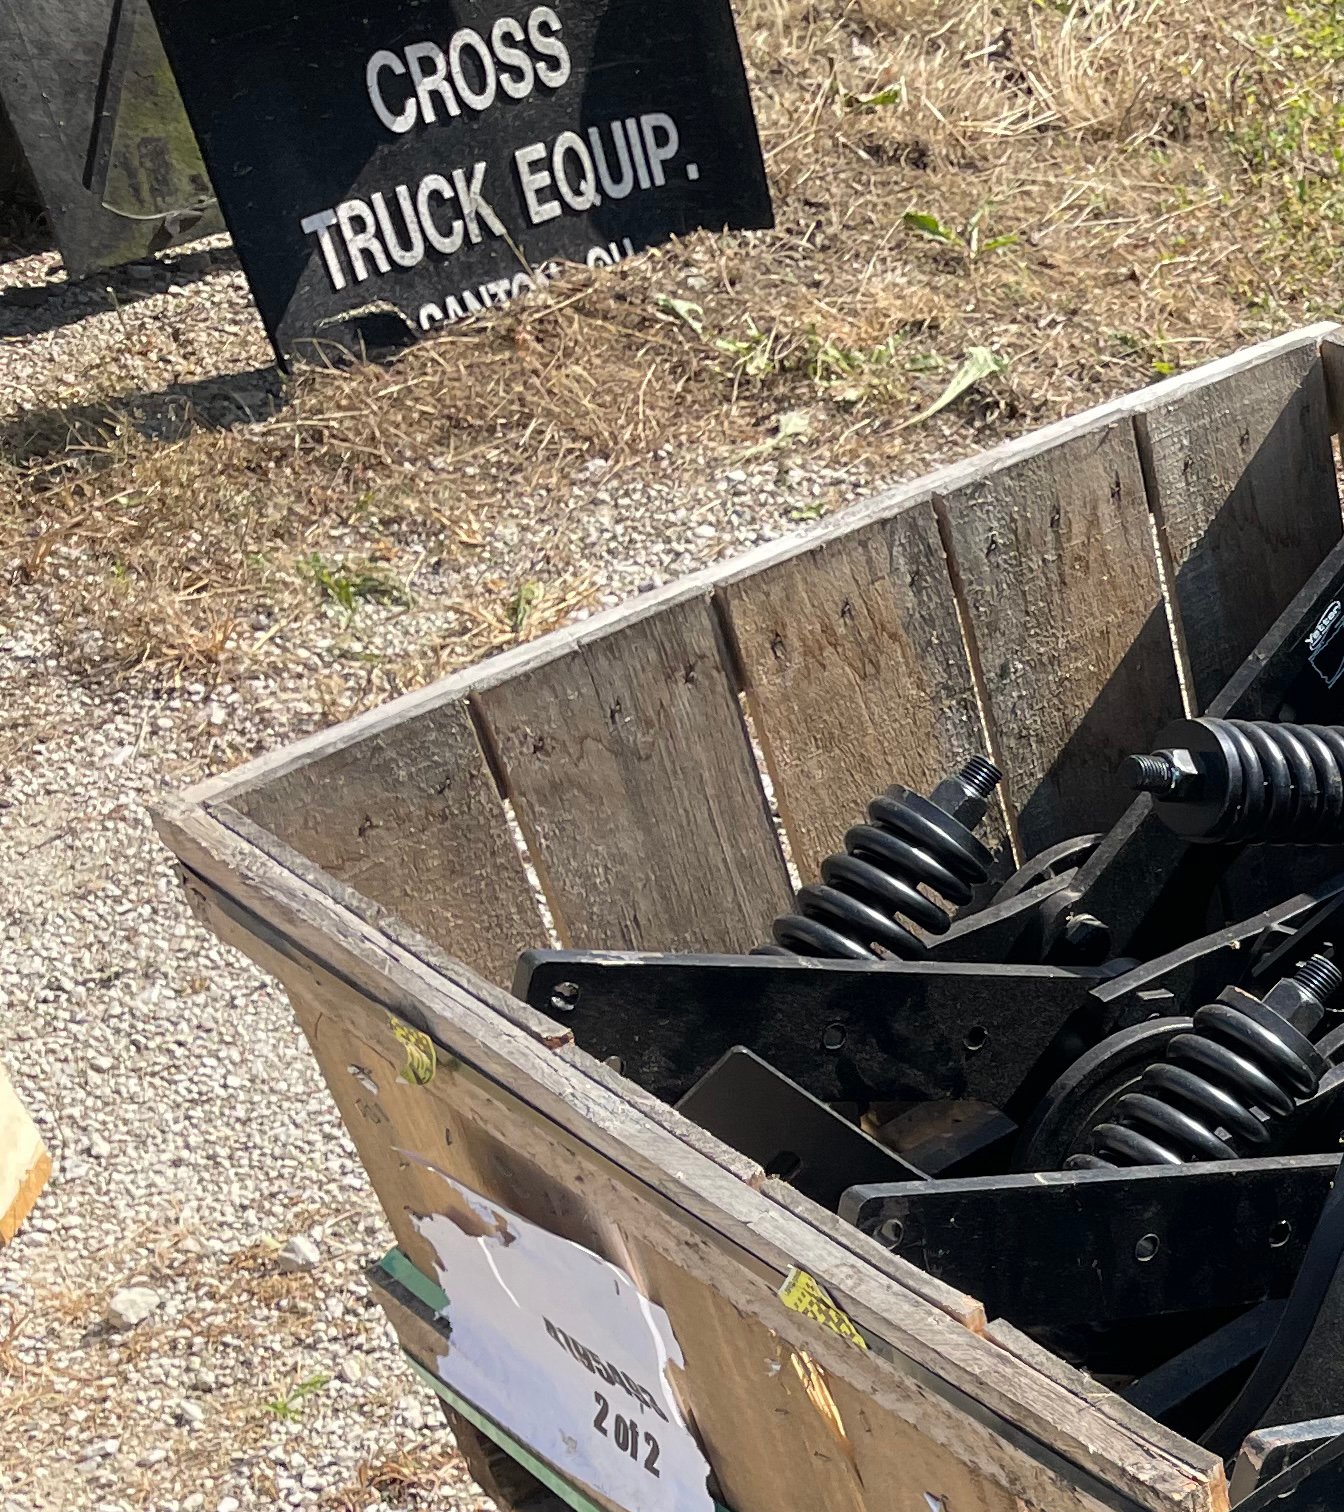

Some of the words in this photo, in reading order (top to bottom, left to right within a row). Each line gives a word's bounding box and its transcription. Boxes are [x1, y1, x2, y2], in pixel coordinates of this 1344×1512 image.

[366, 5, 571, 134] CROSS
[301, 161, 506, 290] TRUCK
[515, 112, 700, 224] EQUIP.
[1304, 603, 1341, 644] Yetter
[593, 1391, 610, 1437] 2
[614, 1413, 640, 1461] of
[644, 1431, 661, 1478] 2
